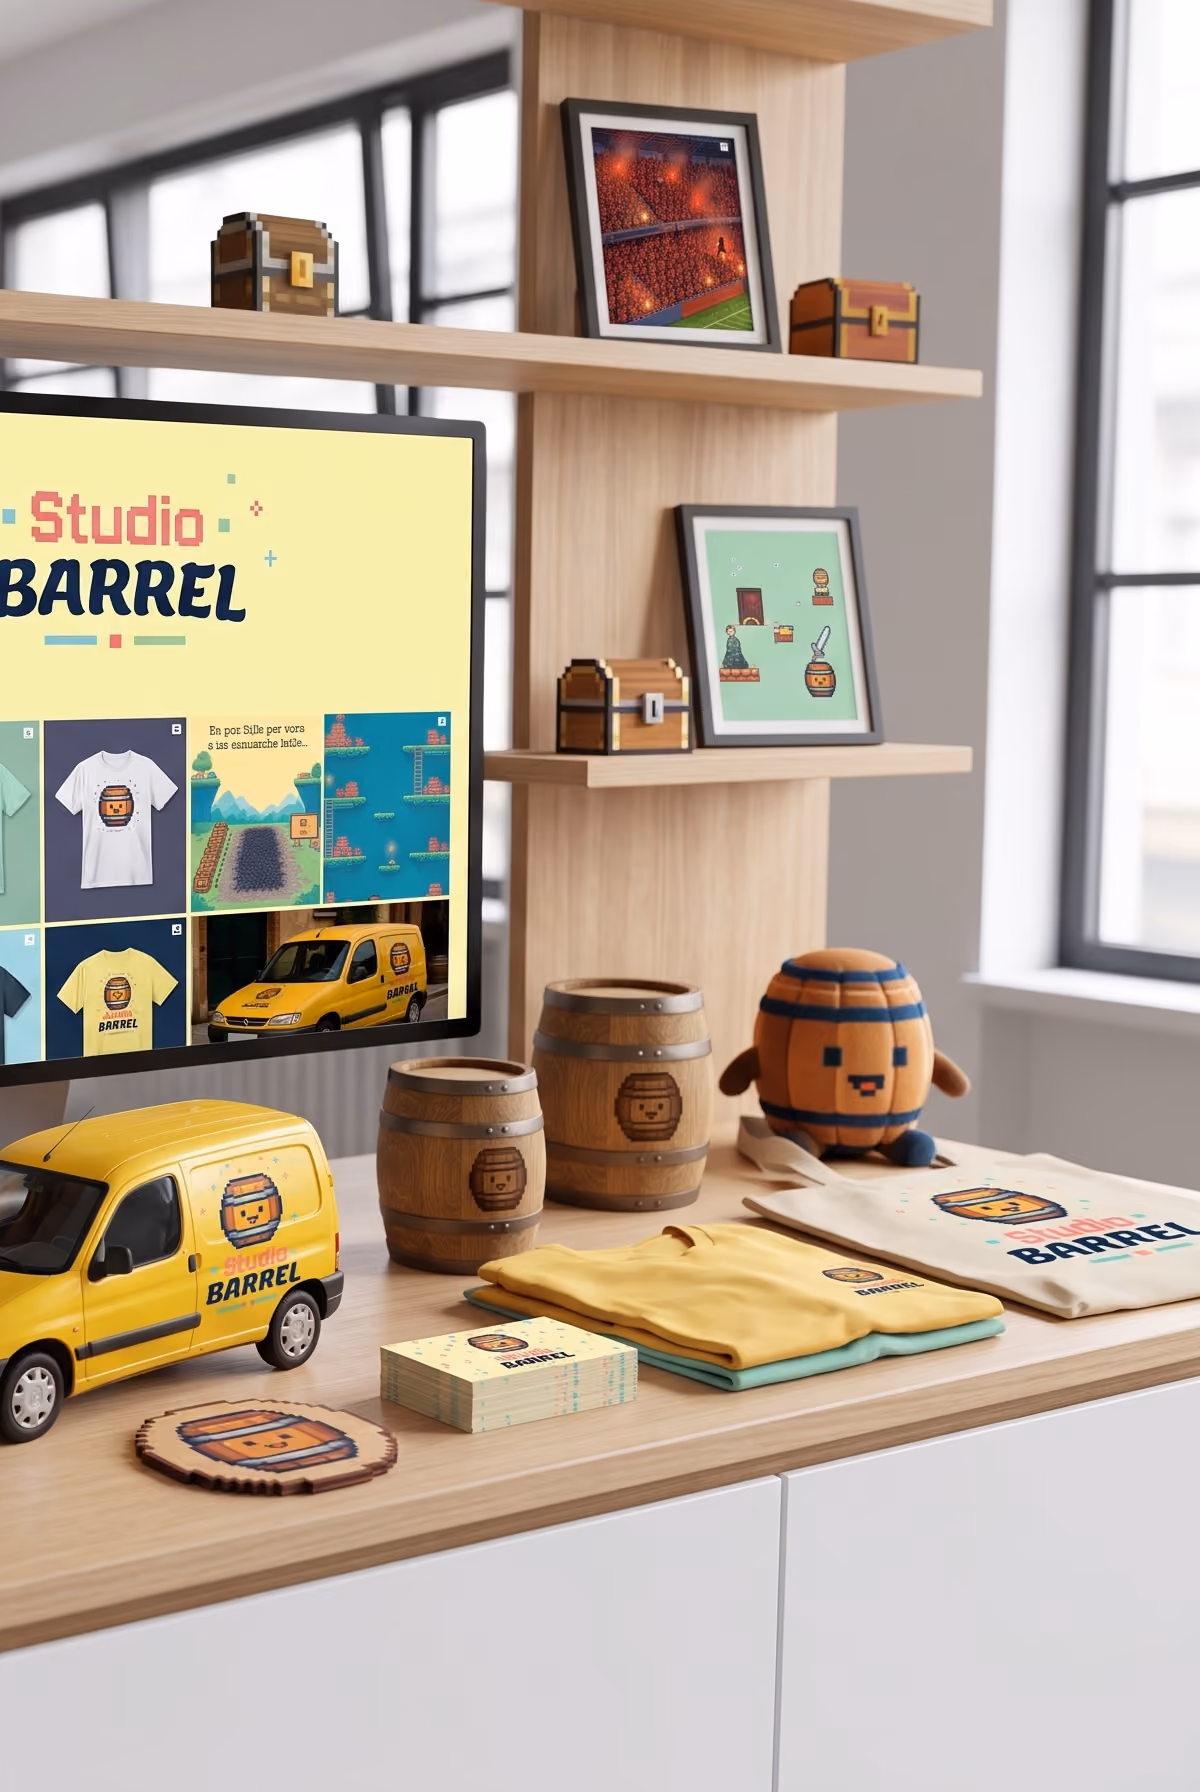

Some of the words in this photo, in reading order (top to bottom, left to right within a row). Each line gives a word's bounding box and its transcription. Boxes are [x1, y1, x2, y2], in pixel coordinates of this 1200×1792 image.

[31, 490, 204, 546] Studio
[284, 725, 305, 734] vors
[1003, 1216, 1137, 1245] Studio
[1006, 1221, 1200, 1265] BARREL
[223, 1246, 289, 1277] Studio
[206, 1261, 301, 1306] BARREL
